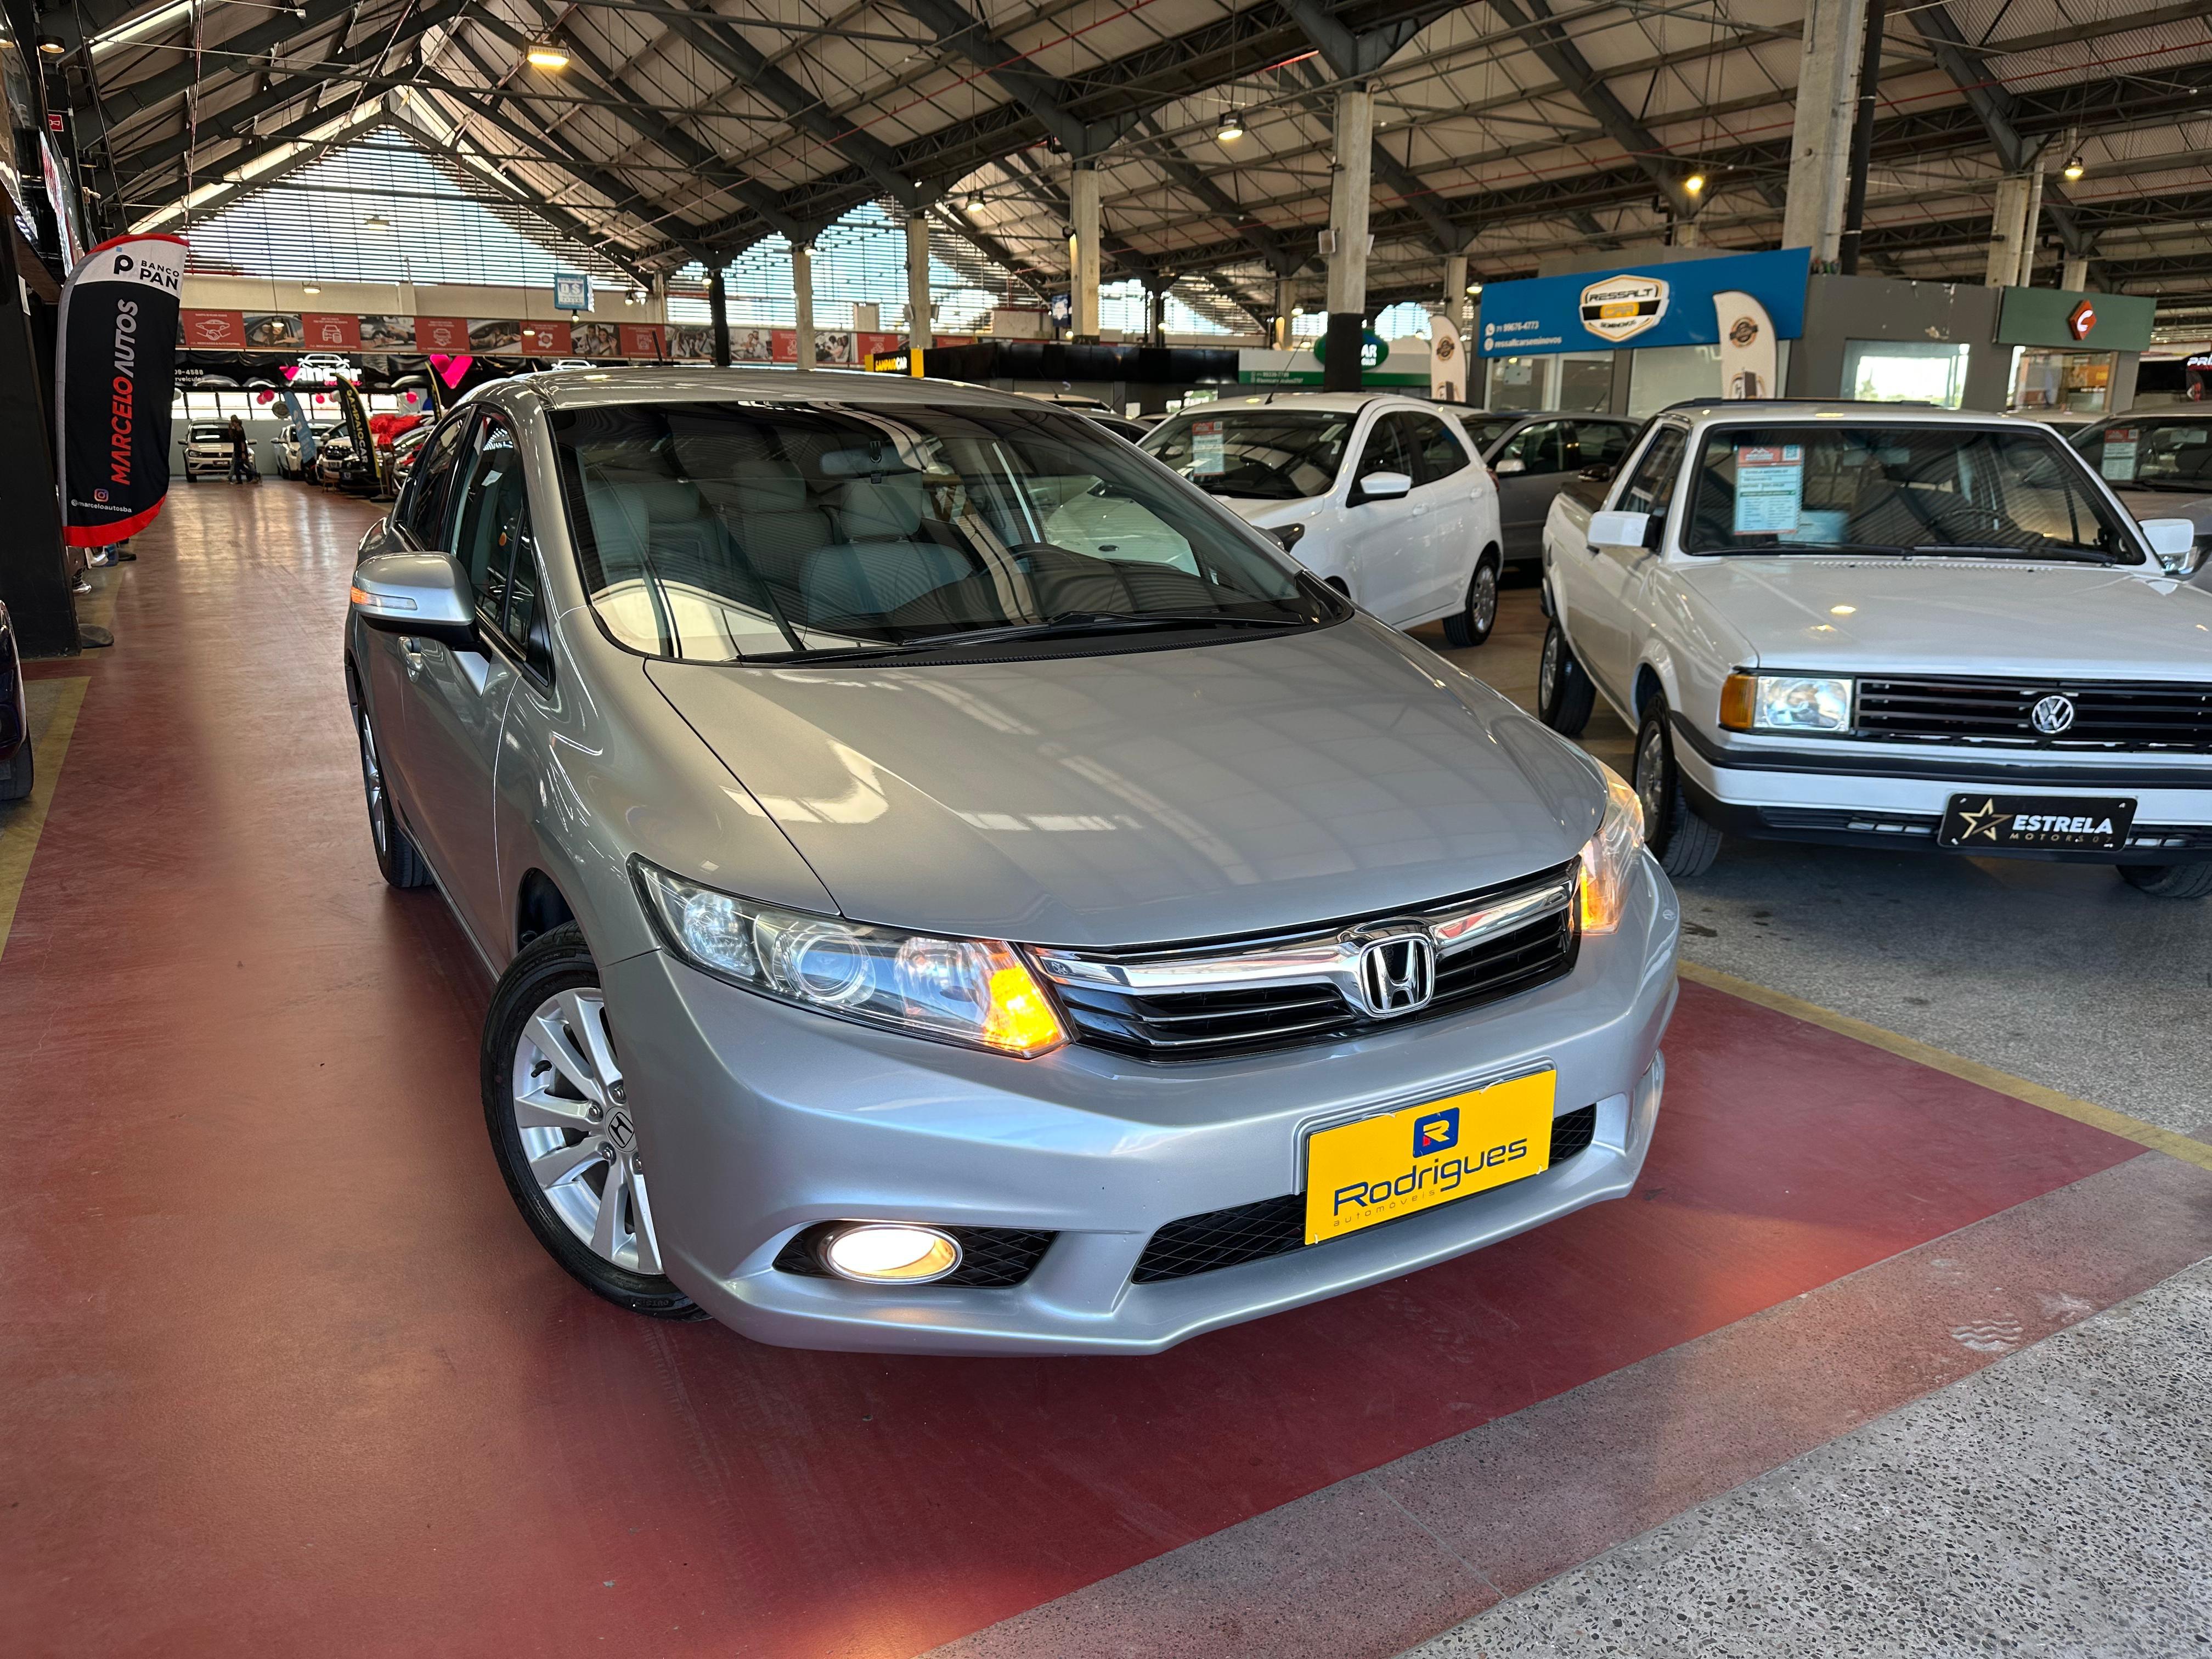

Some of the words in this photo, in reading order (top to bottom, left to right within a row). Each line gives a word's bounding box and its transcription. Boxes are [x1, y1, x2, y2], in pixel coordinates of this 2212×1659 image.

[141, 260, 179, 278] BANCO
[140, 268, 178, 290] PAN
[1589, 288, 1653, 302] RESSALT
[1605, 306, 1634, 317] CAR
[71, 499, 132, 512] @marceloautosba
[2012, 814, 2113, 834] ESTRELA
[2009, 833, 2084, 843] MOTORS
[1334, 1138, 1527, 1216] Rodrigues
[1334, 1189, 1435, 1227] automóveis
